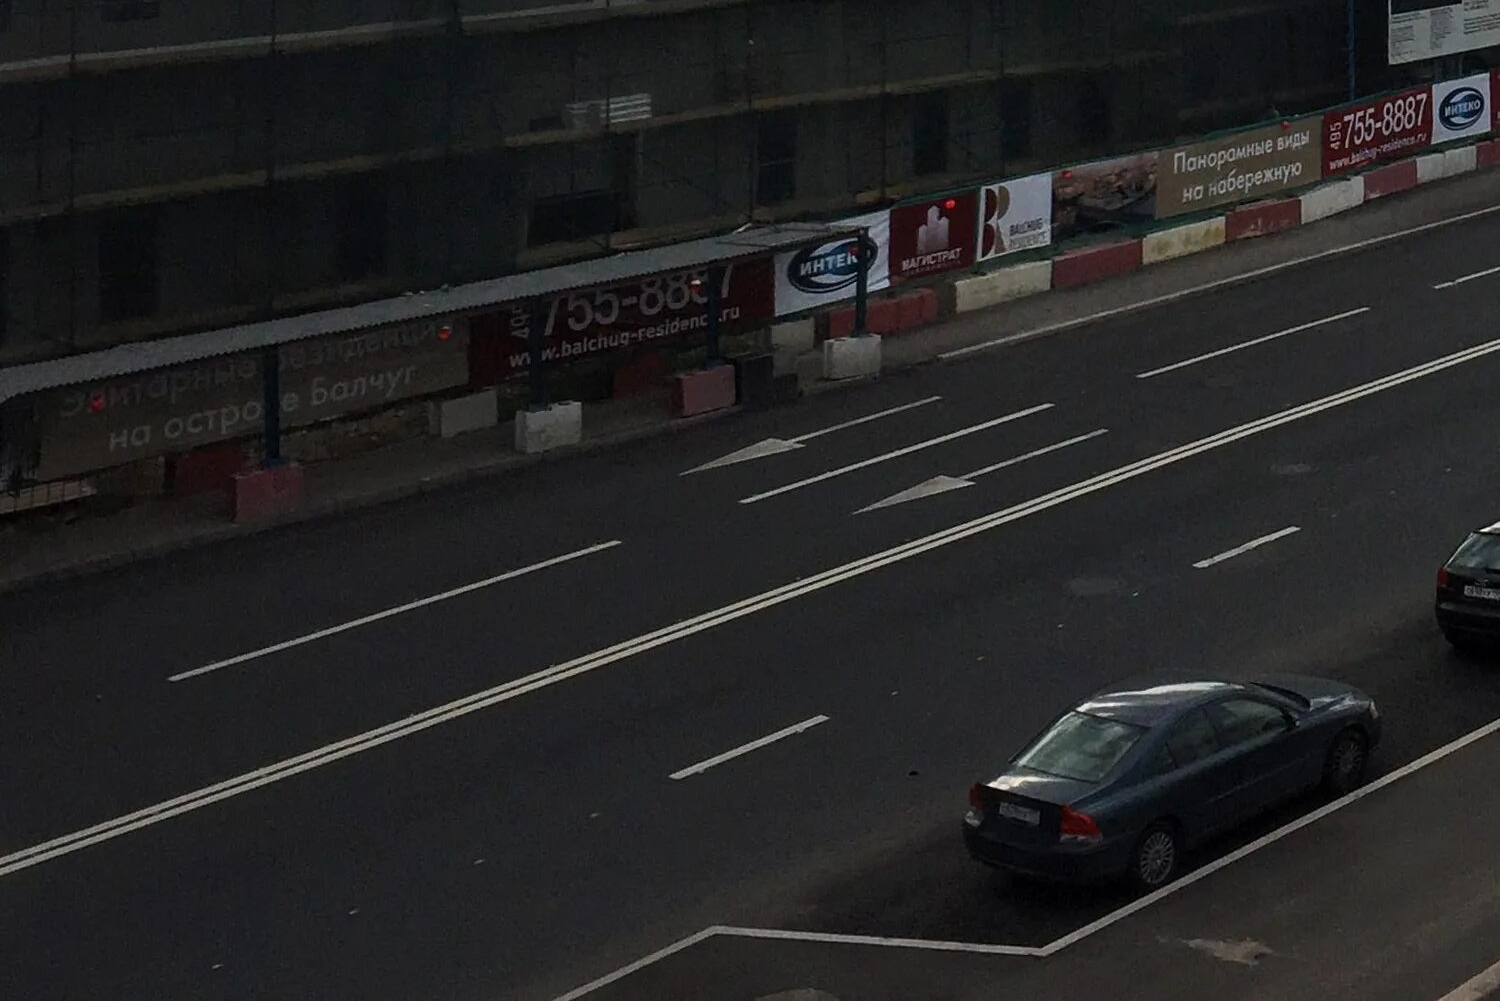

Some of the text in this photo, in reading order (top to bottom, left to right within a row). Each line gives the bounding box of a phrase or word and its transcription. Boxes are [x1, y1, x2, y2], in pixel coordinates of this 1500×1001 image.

[1329, 93, 1427, 149] 495 755-8887
[1173, 130, 1310, 174] Панорамные виды
[1182, 162, 1302, 203] на набережную
[800, 249, 859, 277] ИНТЕК
[508, 305, 740, 368] www.balchug-residenc.ru
[109, 364, 416, 451] на острое Балчуг
